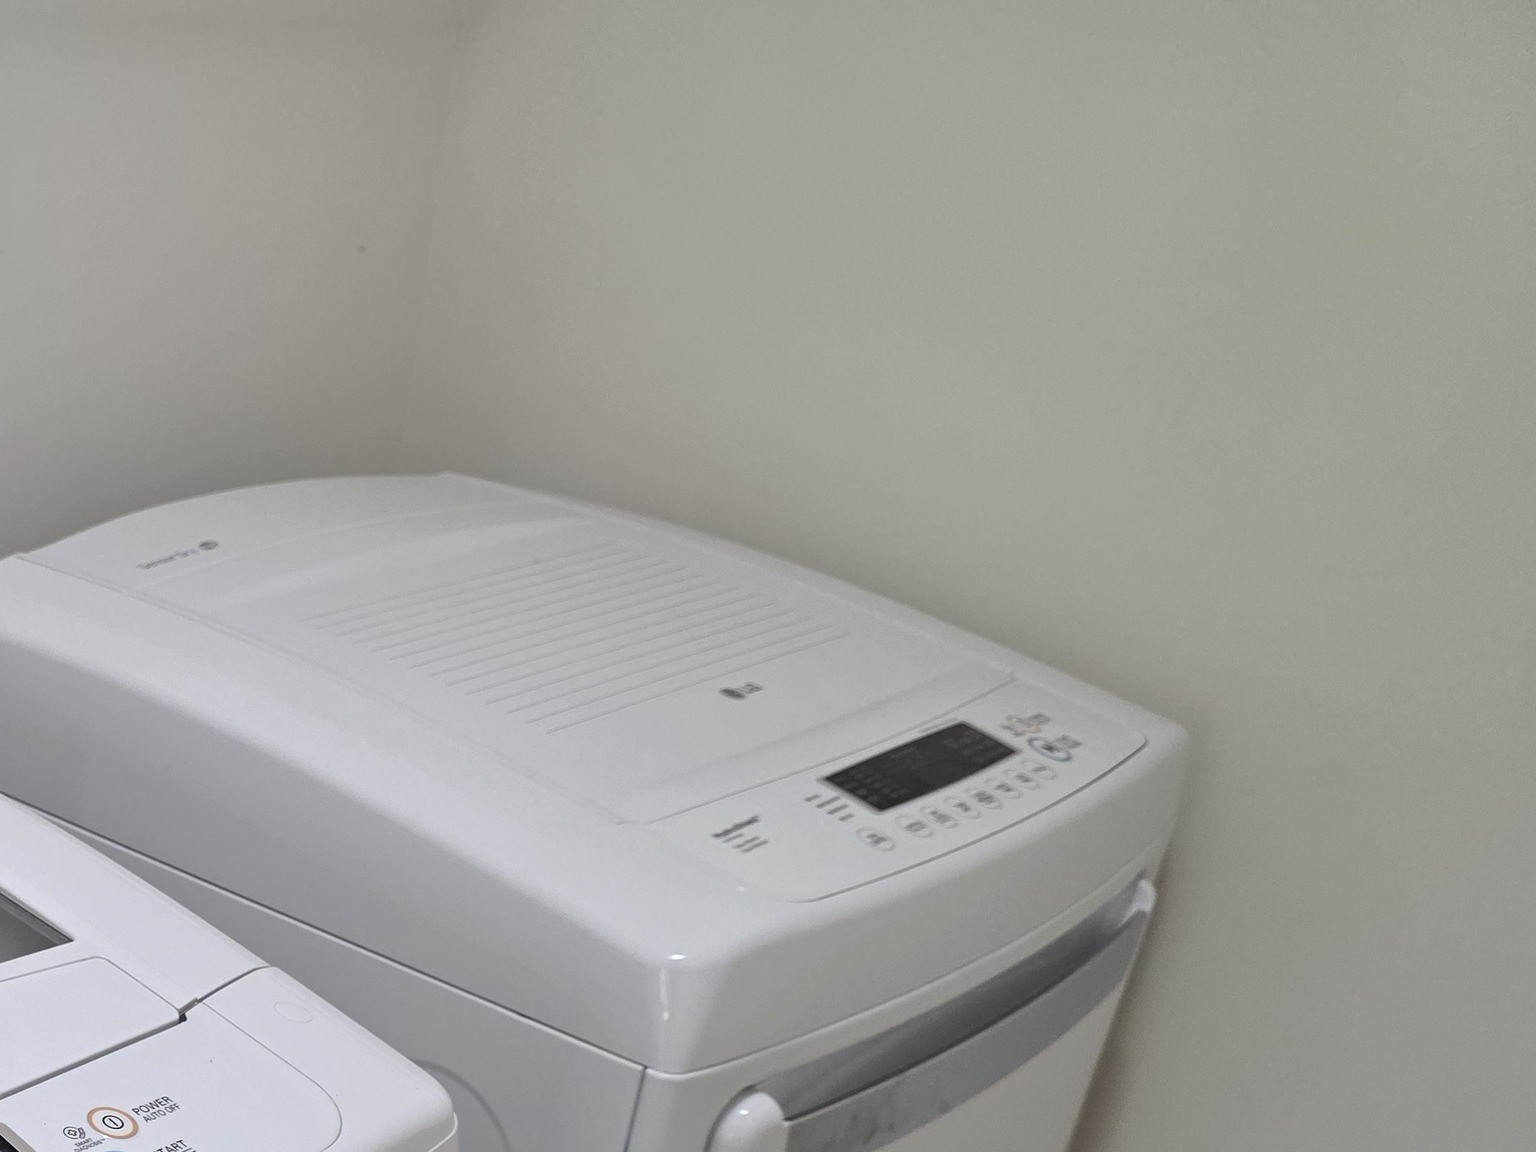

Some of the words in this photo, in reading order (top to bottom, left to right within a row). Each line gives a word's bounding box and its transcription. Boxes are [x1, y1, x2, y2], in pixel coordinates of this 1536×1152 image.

[132, 1096, 173, 1116] POWER
[143, 1109, 166, 1123] AUTO
[165, 1103, 180, 1113] OFF
[74, 1137, 93, 1148] SMART
